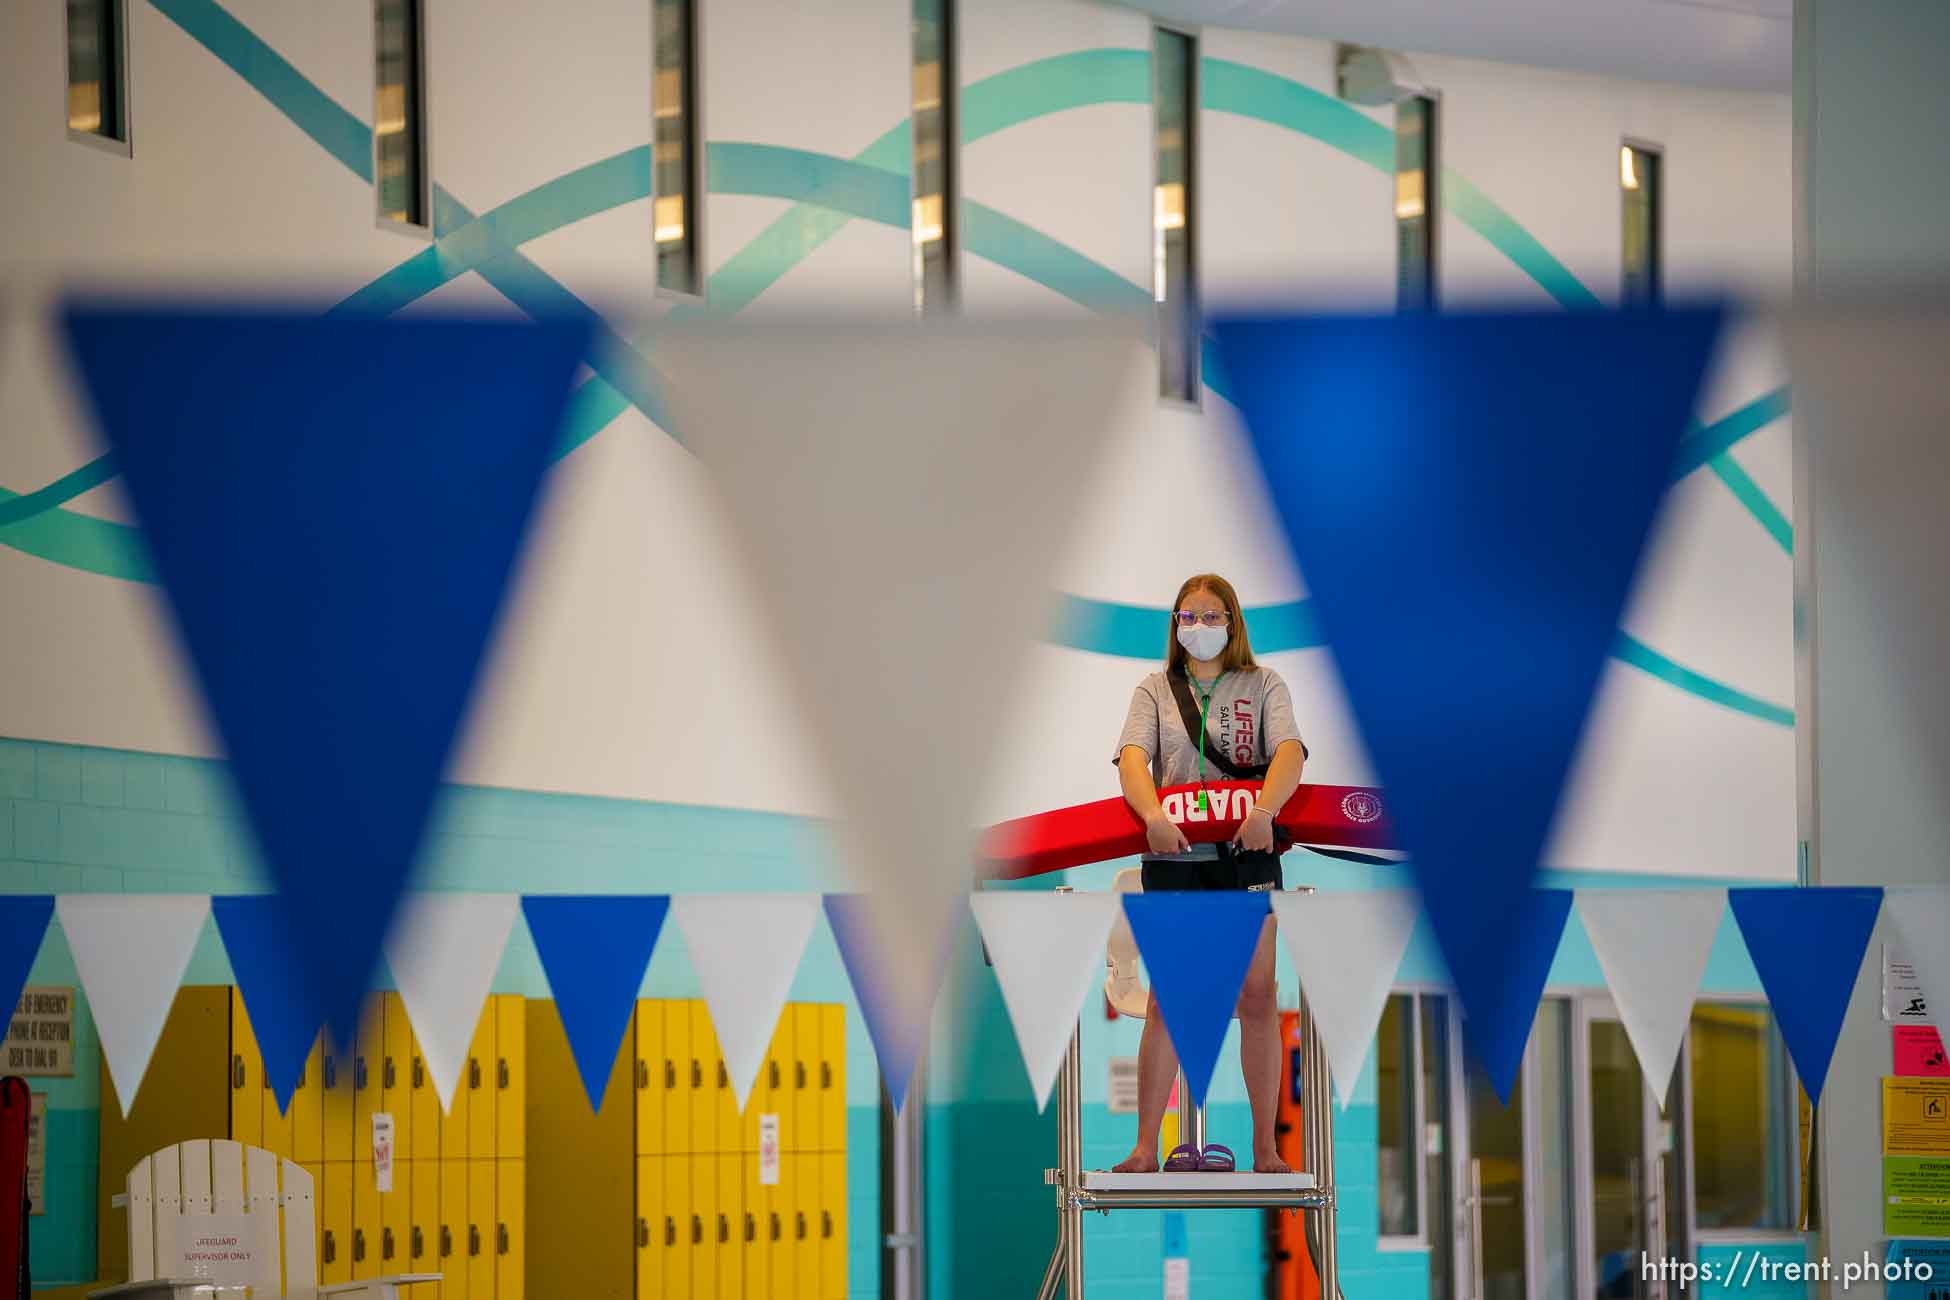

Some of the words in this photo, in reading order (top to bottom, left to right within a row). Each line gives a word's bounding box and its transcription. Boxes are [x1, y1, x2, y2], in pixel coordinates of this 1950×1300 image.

[1220, 706, 1230, 730] SALT
[1220, 733, 1230, 756] LAK
[1233, 699, 1254, 768] LIFEG
[1161, 788, 1262, 823] UARD
[184, 1252, 228, 1261] SUPERVISOR
[230, 1252, 250, 1260] ONLY
